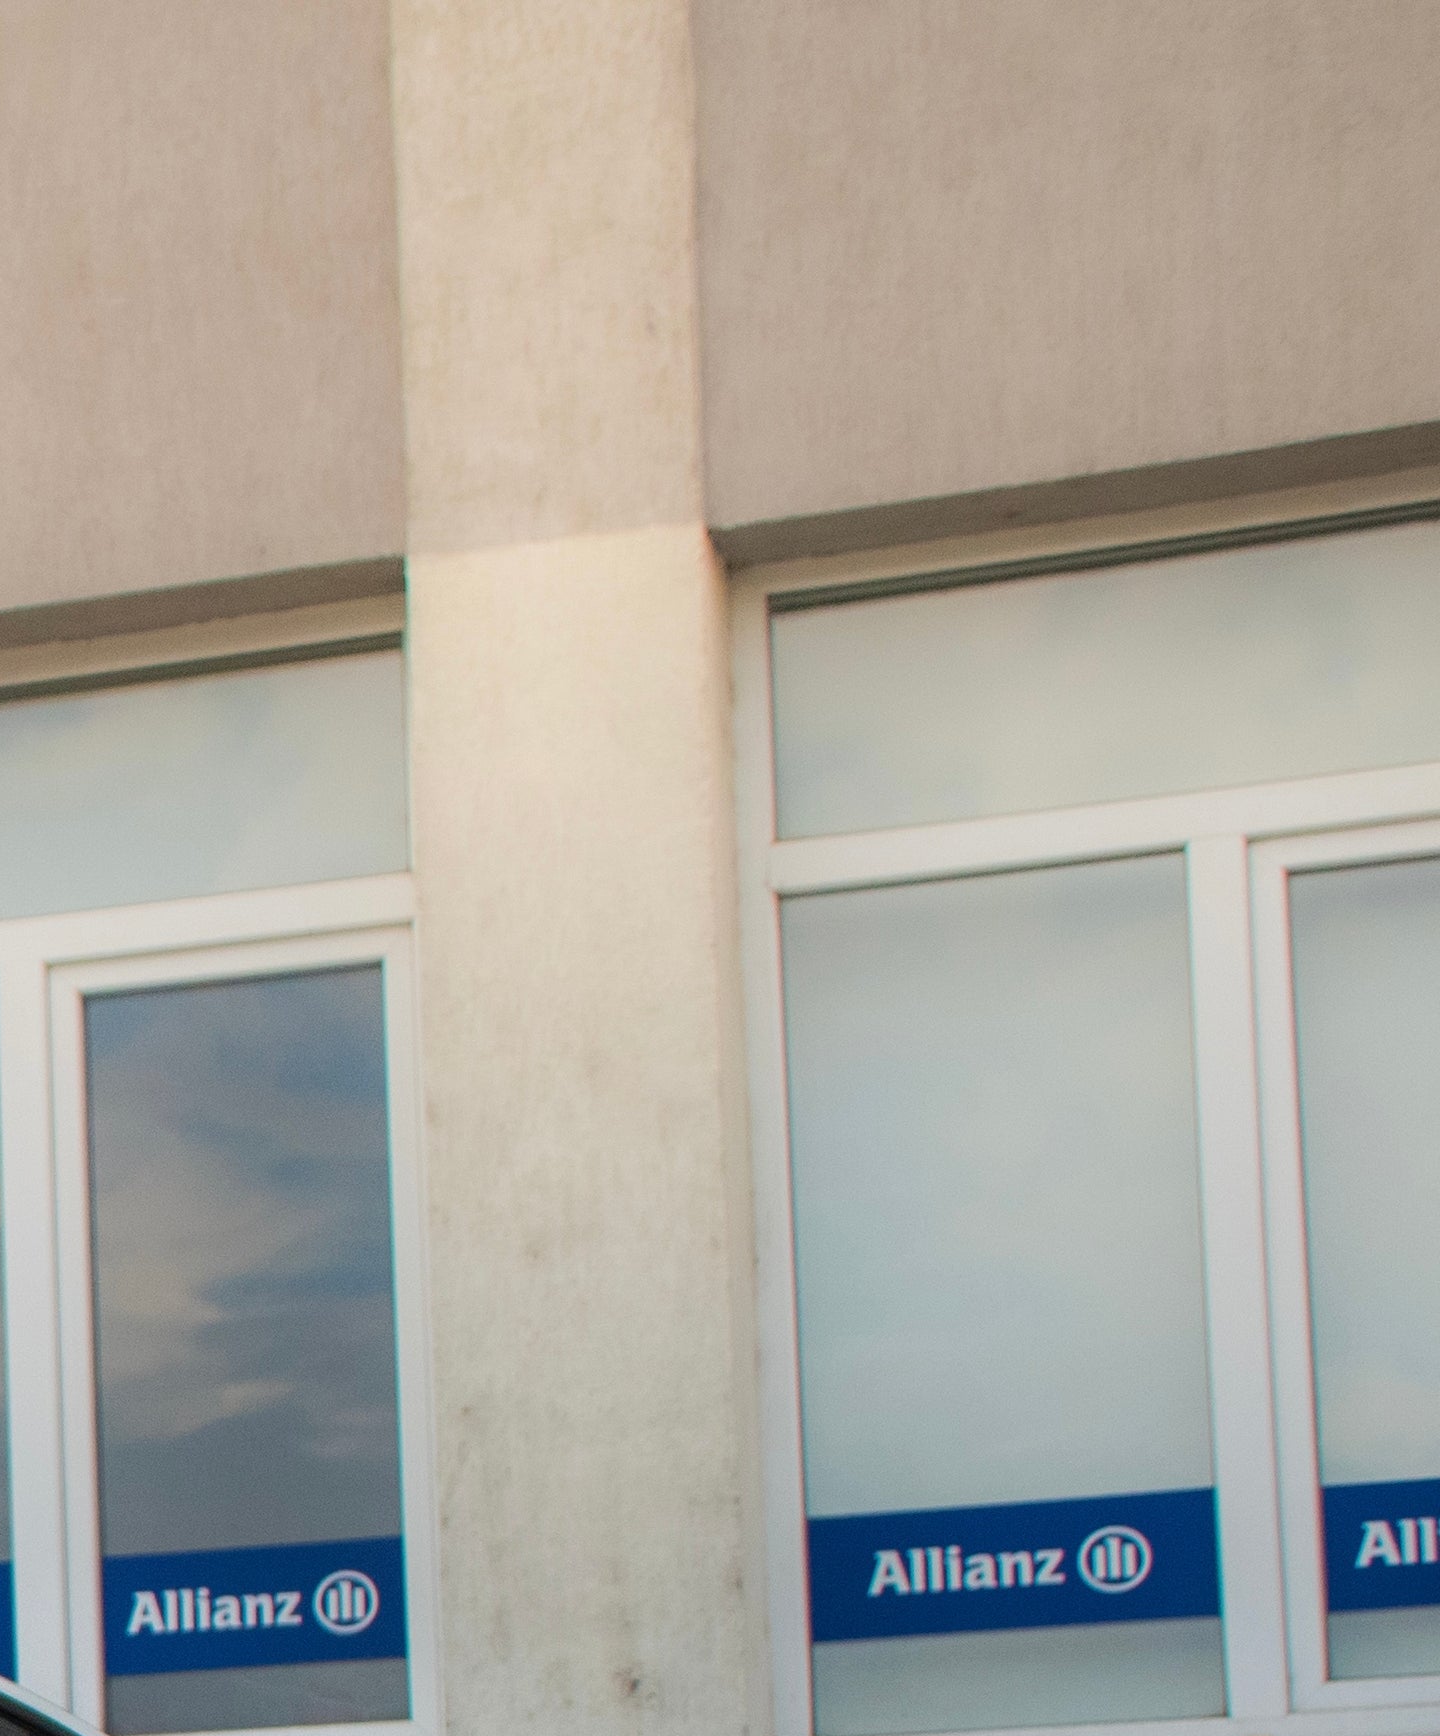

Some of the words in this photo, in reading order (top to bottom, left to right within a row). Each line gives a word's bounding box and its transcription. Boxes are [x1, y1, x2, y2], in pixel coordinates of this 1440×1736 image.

[1354, 1516, 1440, 1569] All
[867, 1545, 1066, 1597] Allianz
[126, 1587, 302, 1635] Allianz
